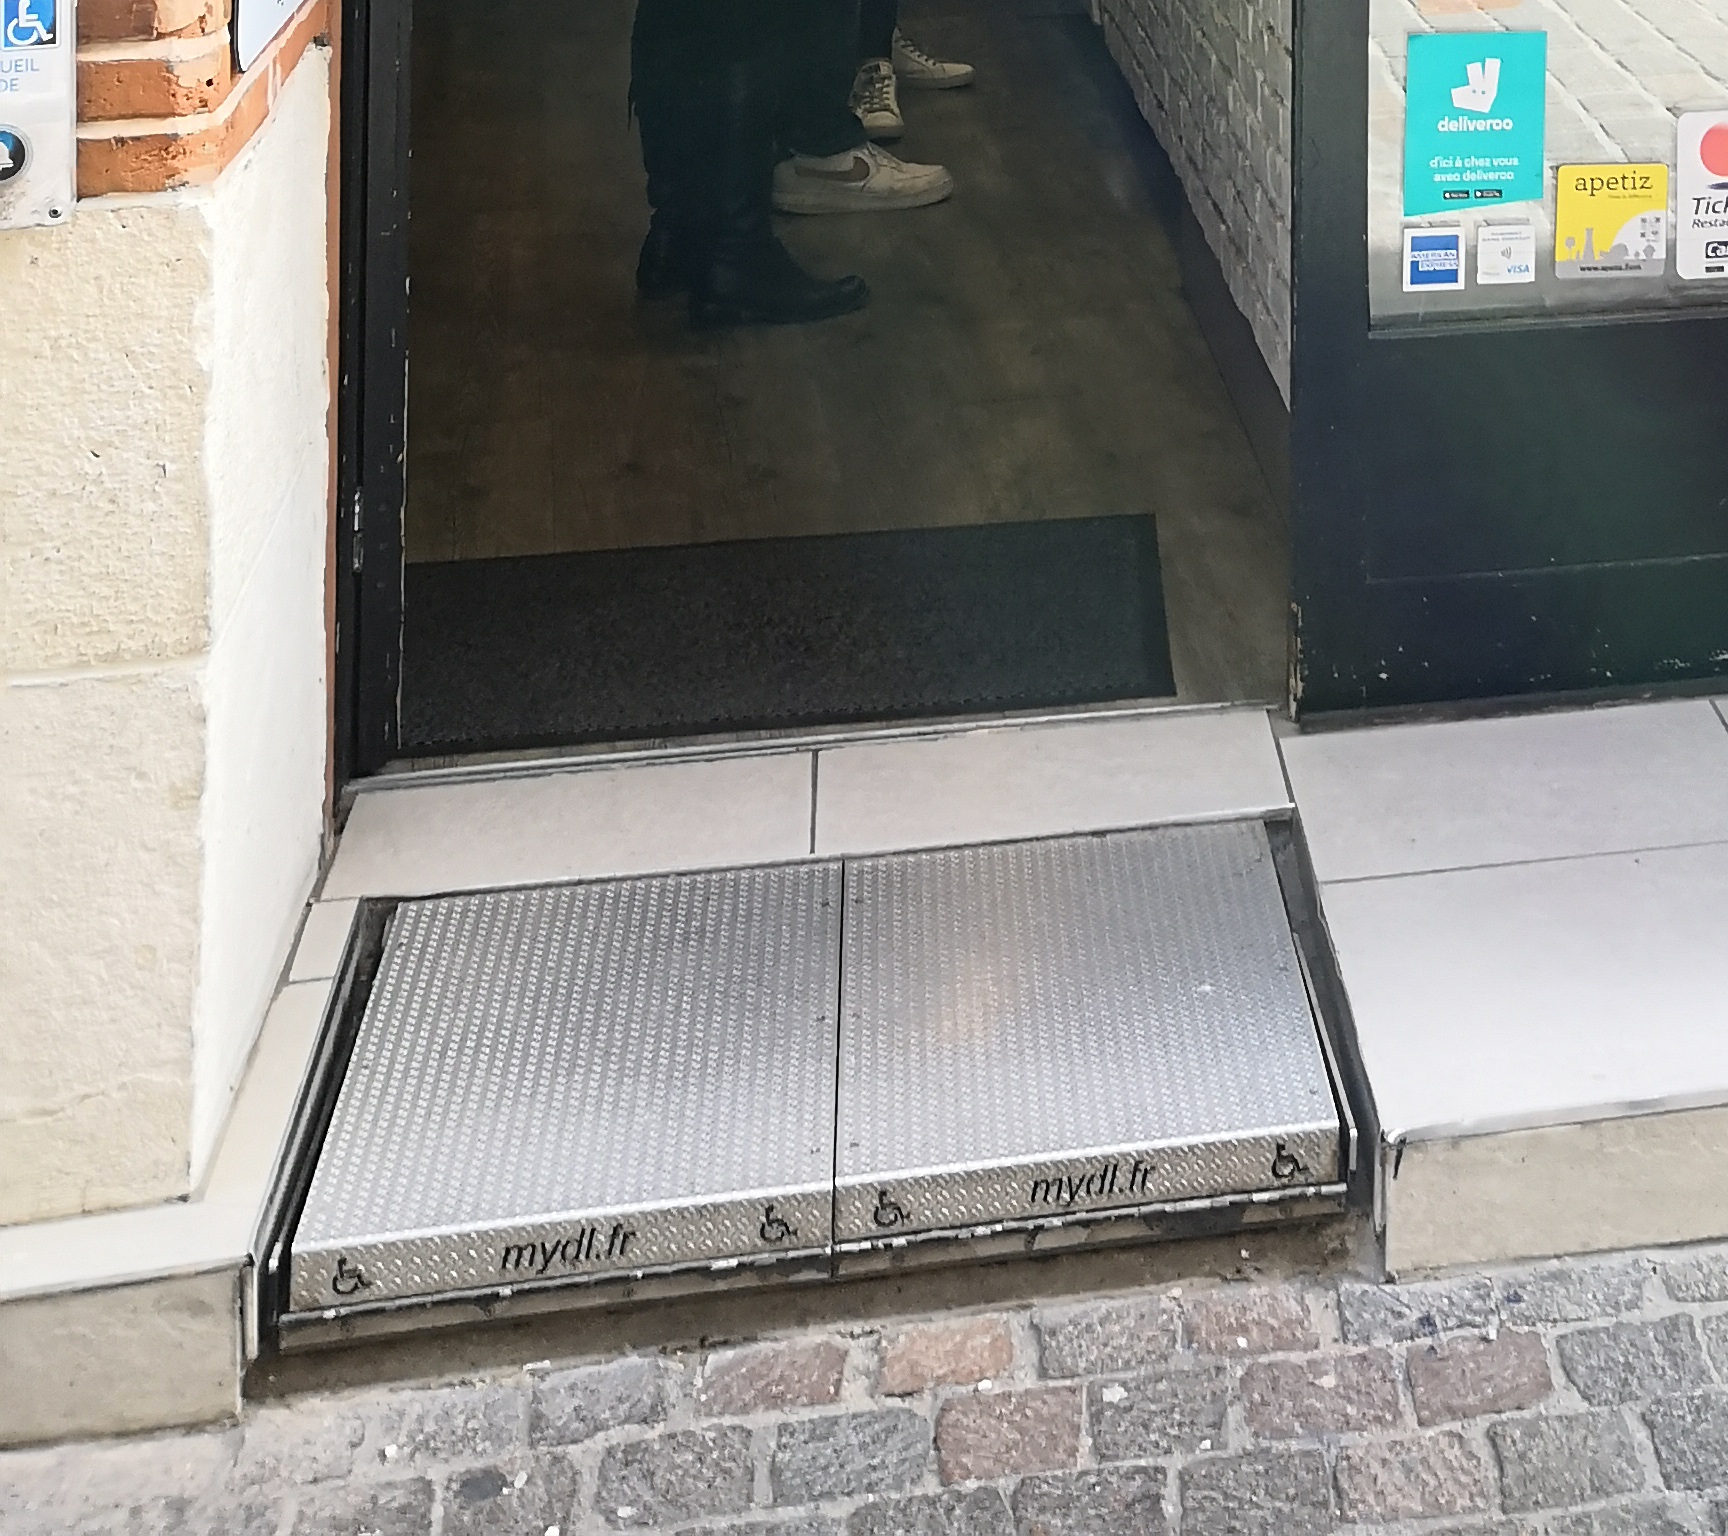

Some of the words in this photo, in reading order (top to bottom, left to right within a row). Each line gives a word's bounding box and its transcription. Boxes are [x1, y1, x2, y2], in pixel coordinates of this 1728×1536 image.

[1438, 116, 1513, 132] deliveroo
[1429, 156, 1454, 168] d'ici
[1464, 155, 1491, 168] chez
[1492, 157, 1519, 167] vous
[1433, 172, 1461, 182] avec
[1462, 169, 1515, 182] deliveroo
[1574, 170, 1654, 196] apetiz
[1507, 264, 1530, 274] VISA
[1030, 1159, 1156, 1207] mydl.fr
[500, 1222, 637, 1275] mydl.fr
